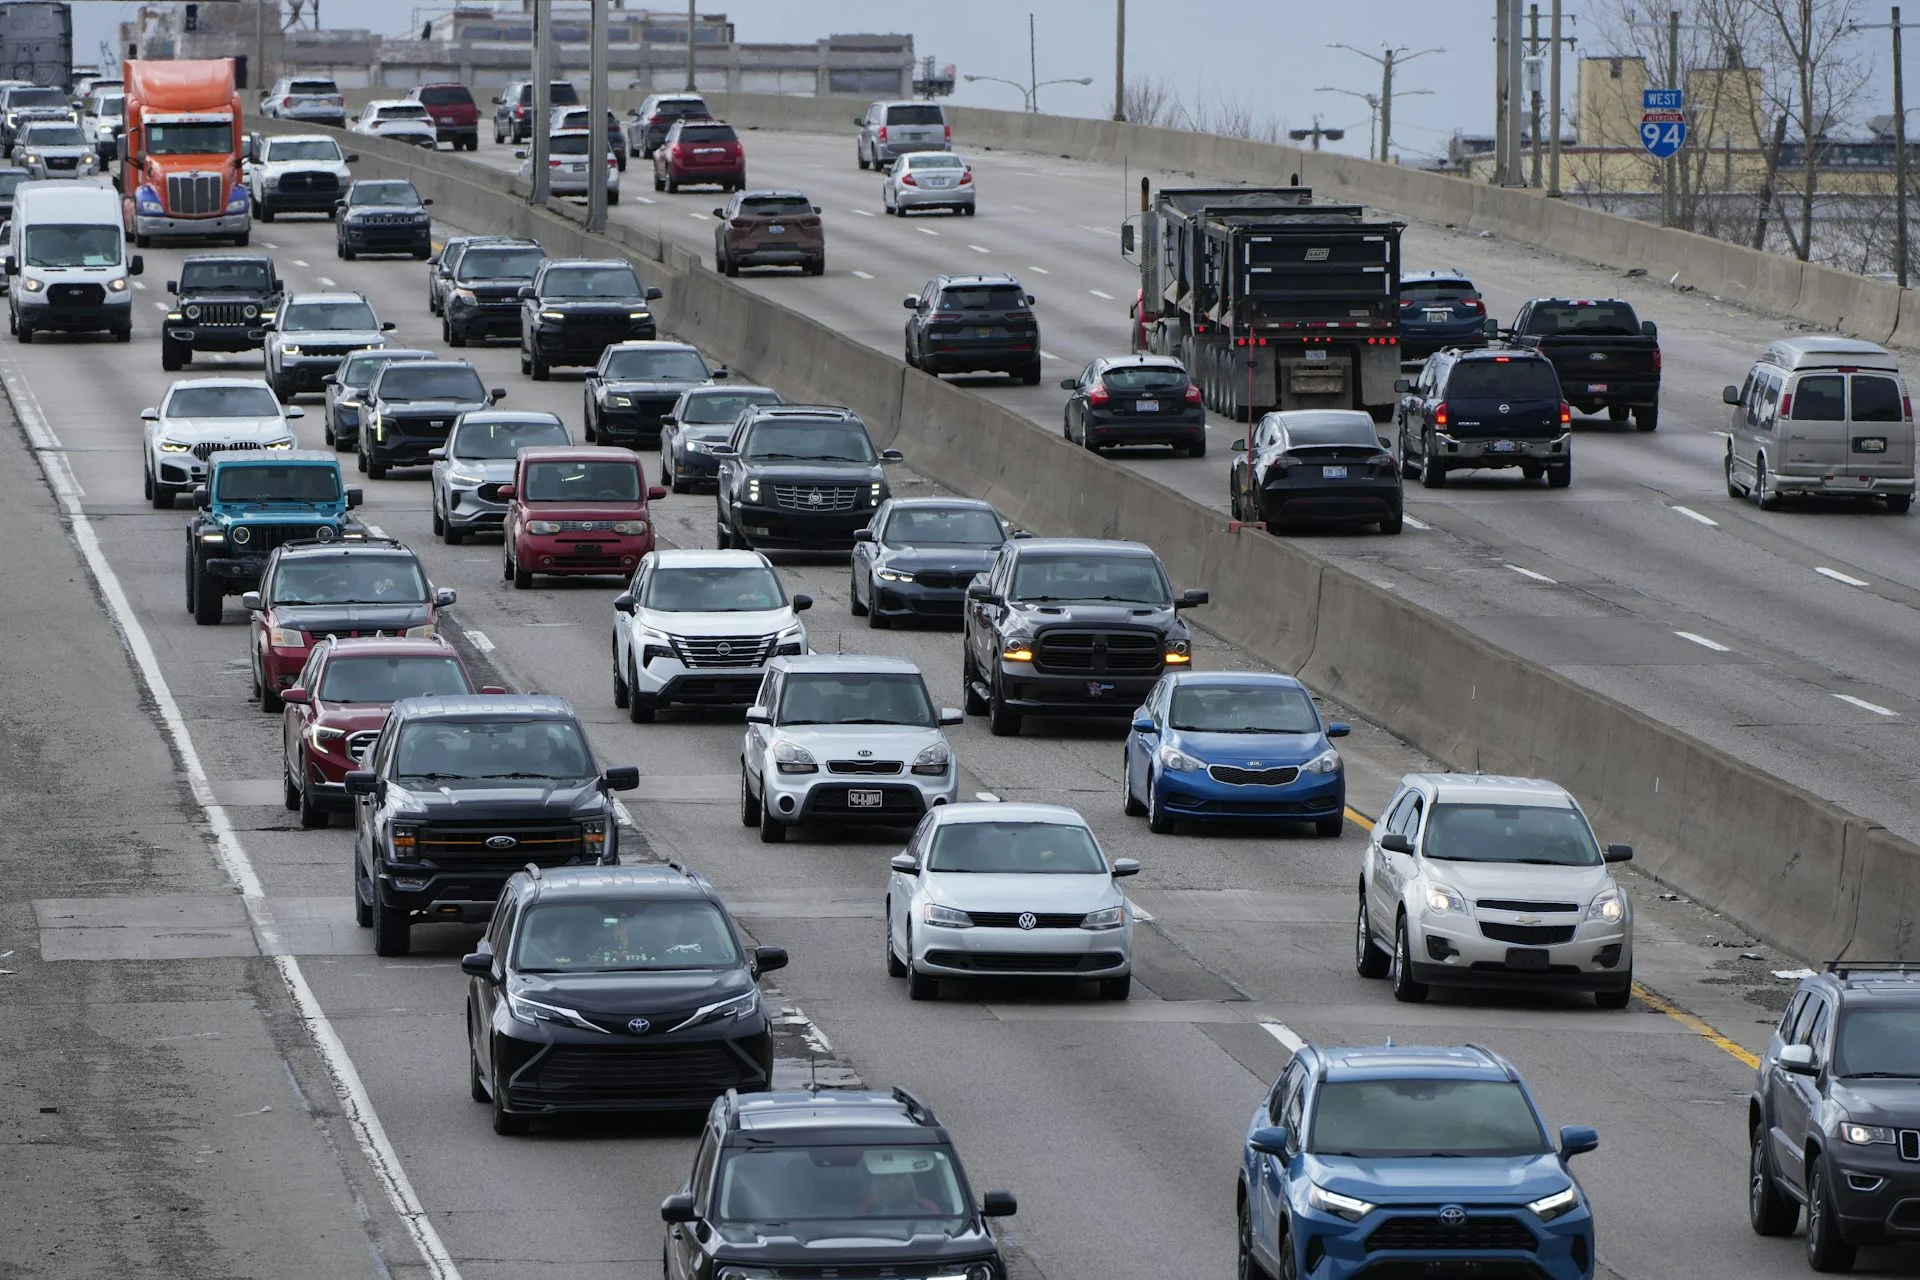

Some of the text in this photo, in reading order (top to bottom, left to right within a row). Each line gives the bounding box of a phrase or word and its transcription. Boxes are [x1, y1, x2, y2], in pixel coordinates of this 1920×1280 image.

[1648, 93, 1677, 105] WEST
[1643, 123, 1680, 149] 94
[1309, 250, 1326, 258] EAST
